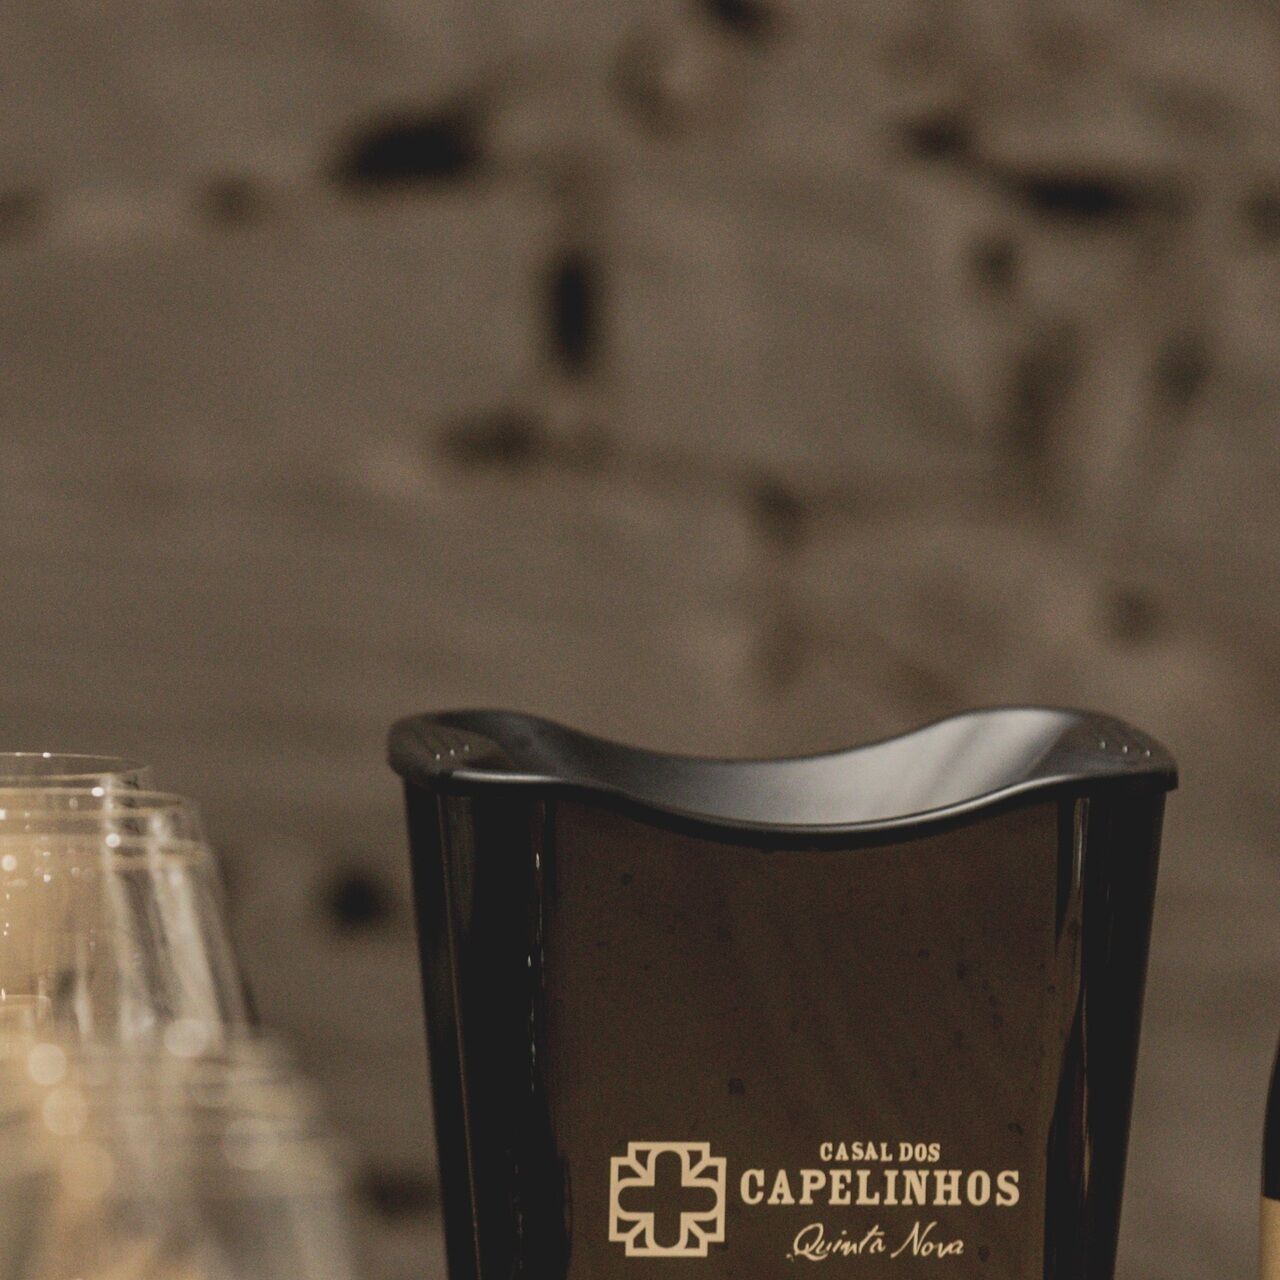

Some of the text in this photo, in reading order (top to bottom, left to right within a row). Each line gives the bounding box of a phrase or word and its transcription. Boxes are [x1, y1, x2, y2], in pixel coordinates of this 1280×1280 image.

[819, 1141, 941, 1163] CASAL DOS
[740, 1168, 1020, 1207] CAPELINHOS
[790, 1220, 965, 1262] Quinta Nova
